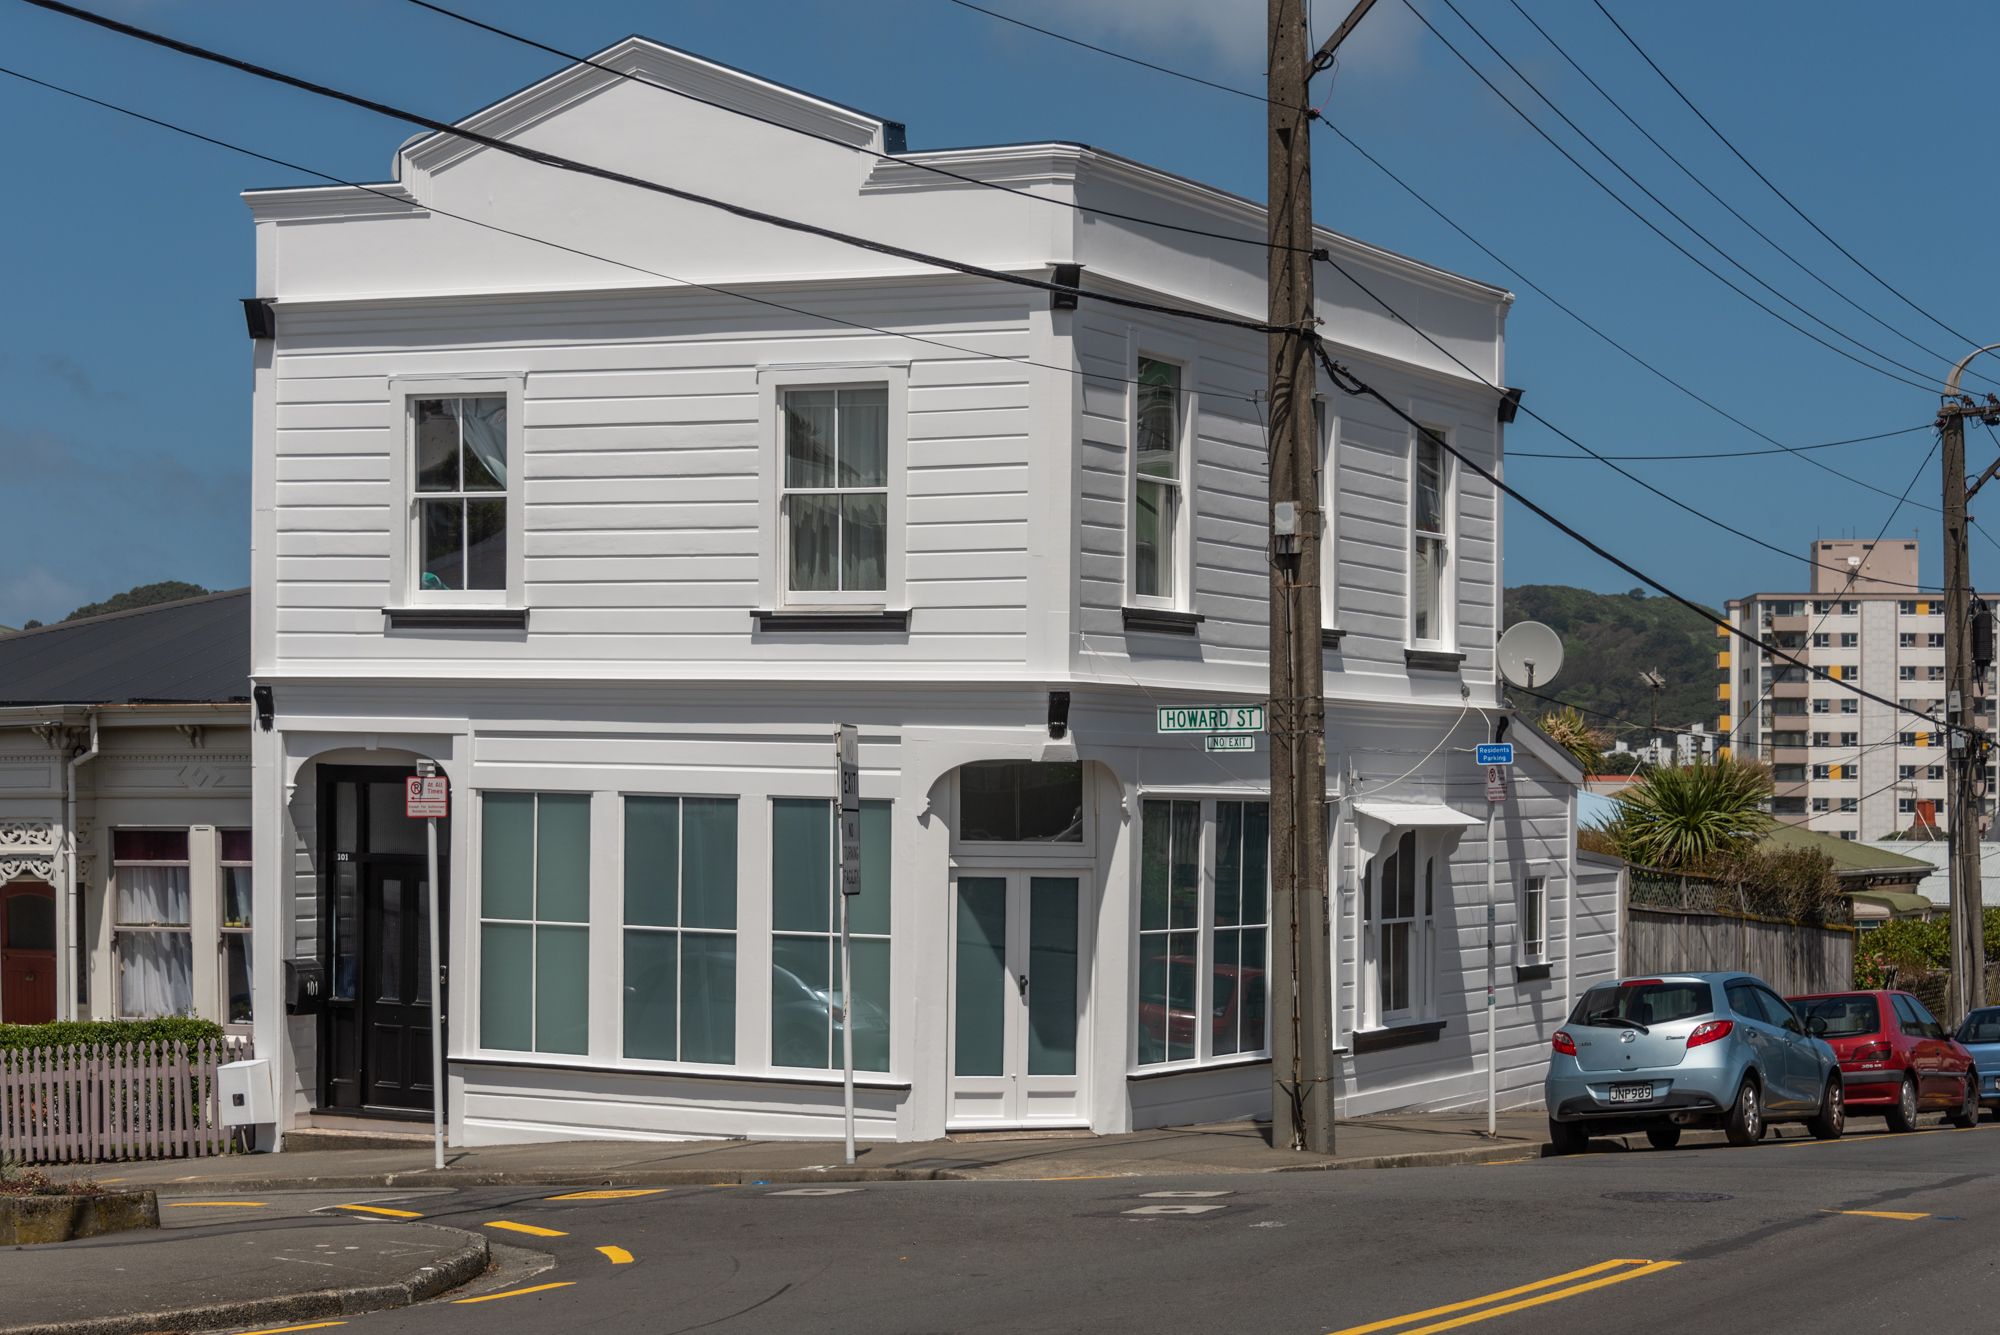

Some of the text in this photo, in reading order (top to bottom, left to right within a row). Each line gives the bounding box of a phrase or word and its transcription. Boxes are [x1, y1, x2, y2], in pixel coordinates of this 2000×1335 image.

[1166, 709, 1255, 728] HOWARD ST
[1213, 737, 1247, 747] NO EXIT
[844, 771, 856, 795] EXIT
[337, 853, 349, 861] 101
[307, 981, 319, 996] 101
